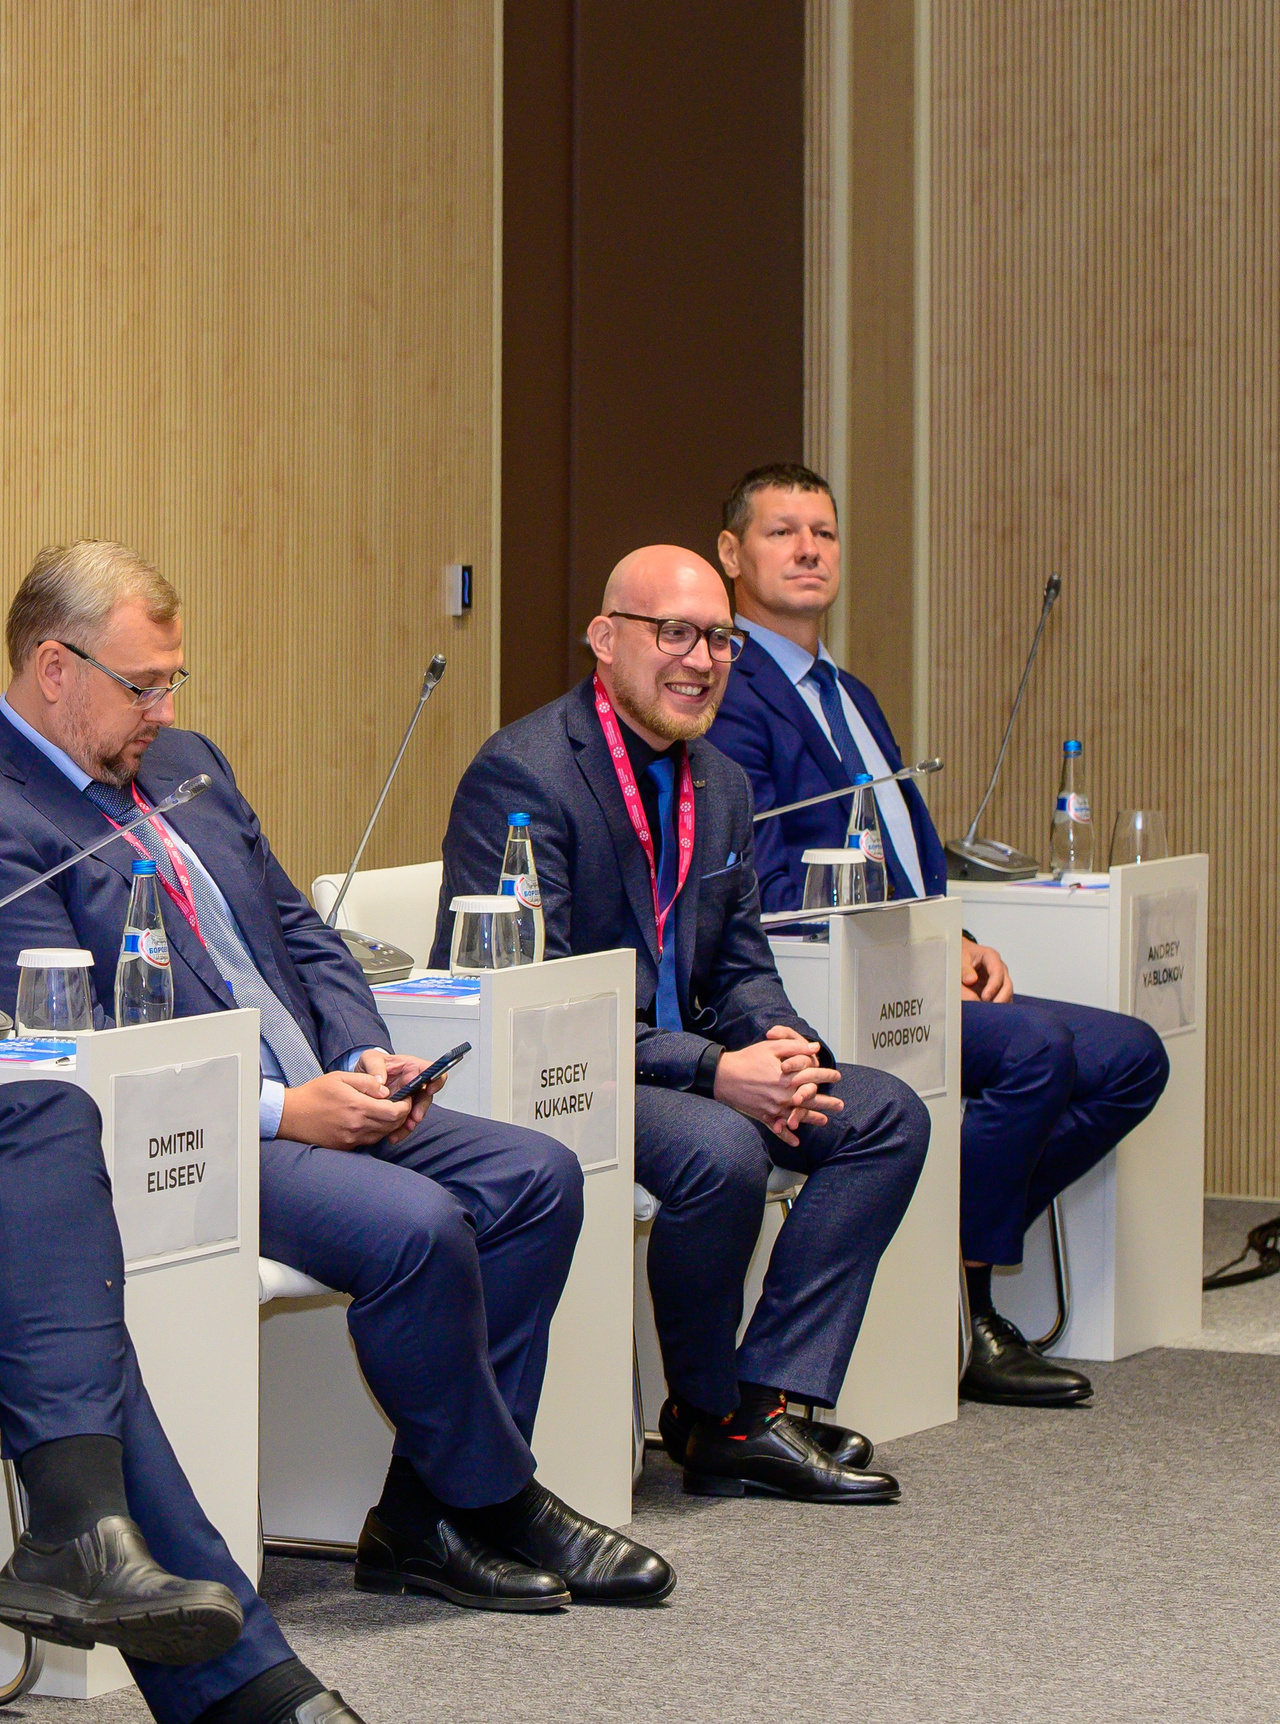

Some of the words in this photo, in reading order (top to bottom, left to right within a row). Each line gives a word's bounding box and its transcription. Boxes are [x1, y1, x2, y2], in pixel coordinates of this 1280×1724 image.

[1148, 940, 1180, 962] ANDREY
[1142, 964, 1185, 988] YABLOKOV
[880, 997, 924, 1021] ANDREY
[871, 1024, 931, 1050] VOROBYOV
[540, 1061, 589, 1089] SERGEY
[534, 1090, 594, 1120] KUKAREV
[148, 1128, 204, 1159] DMITRII
[147, 1161, 206, 1194] ELISEEV
